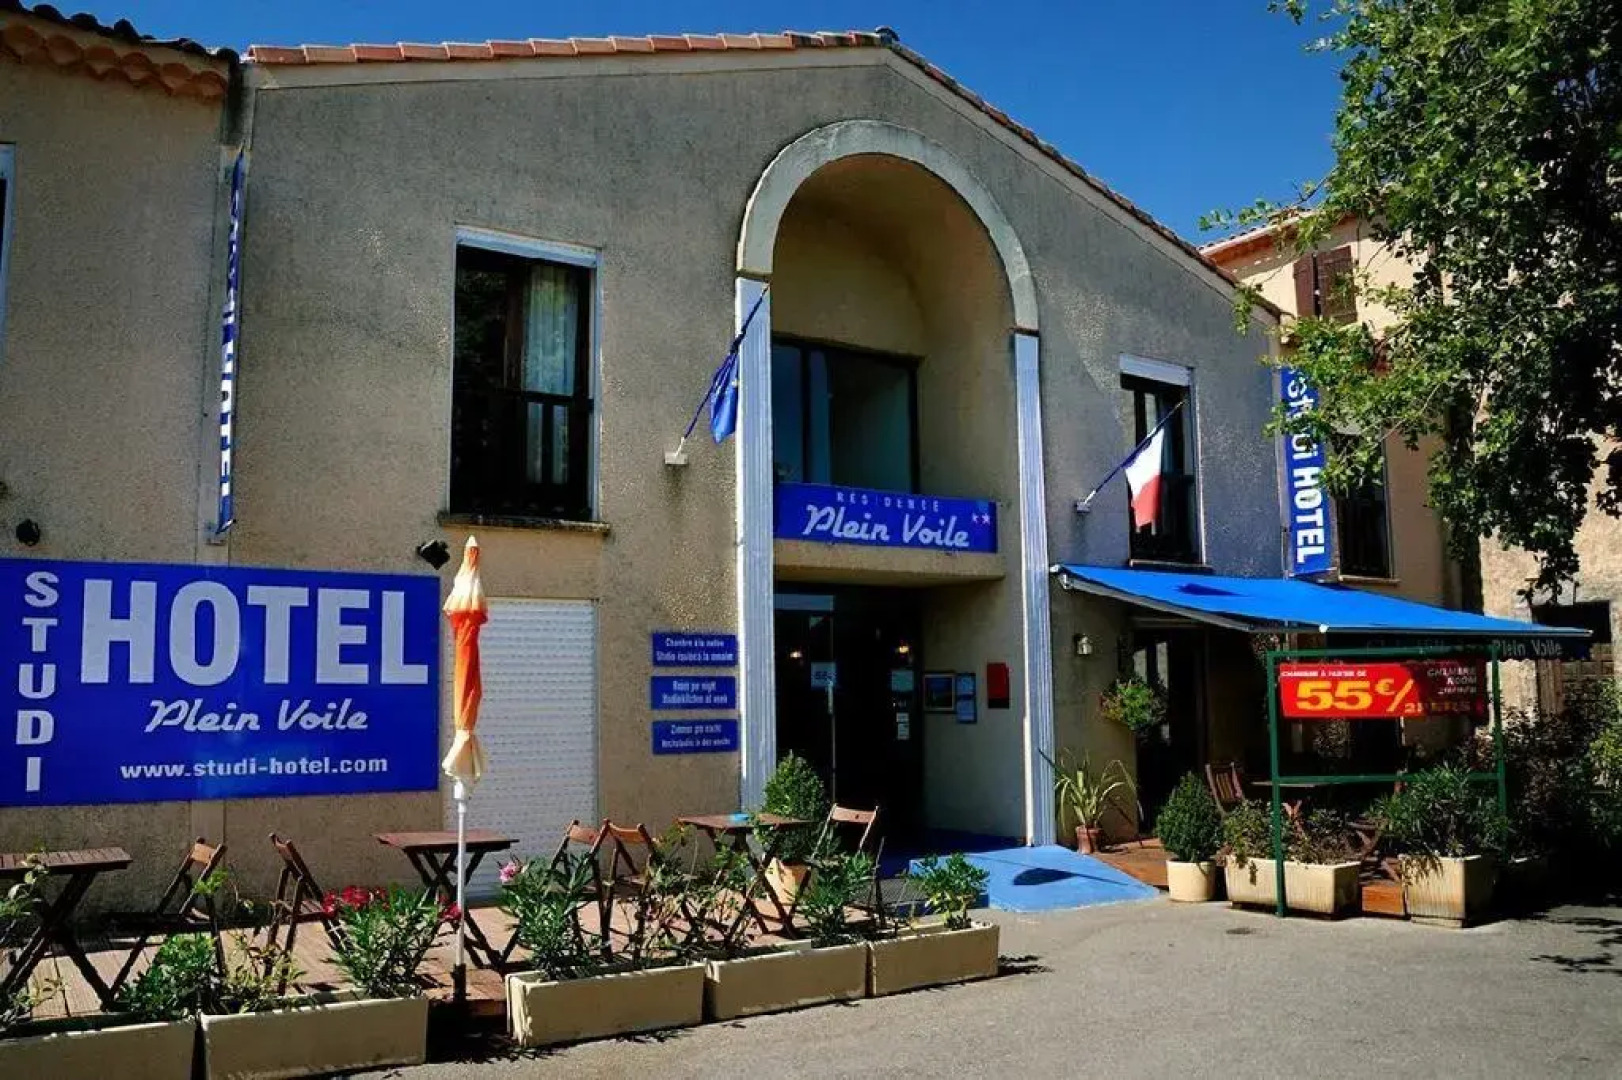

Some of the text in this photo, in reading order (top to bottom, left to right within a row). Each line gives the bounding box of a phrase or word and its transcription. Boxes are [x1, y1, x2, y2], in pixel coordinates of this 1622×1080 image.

[802, 504, 970, 547] Plein Voile
[1293, 466, 1325, 564] HOTEL
[81, 578, 429, 686] HOTEL
[16, 571, 59, 792] STUDI
[144, 698, 369, 733] Plein Voile
[120, 756, 388, 780] www.studi-hotel.com
